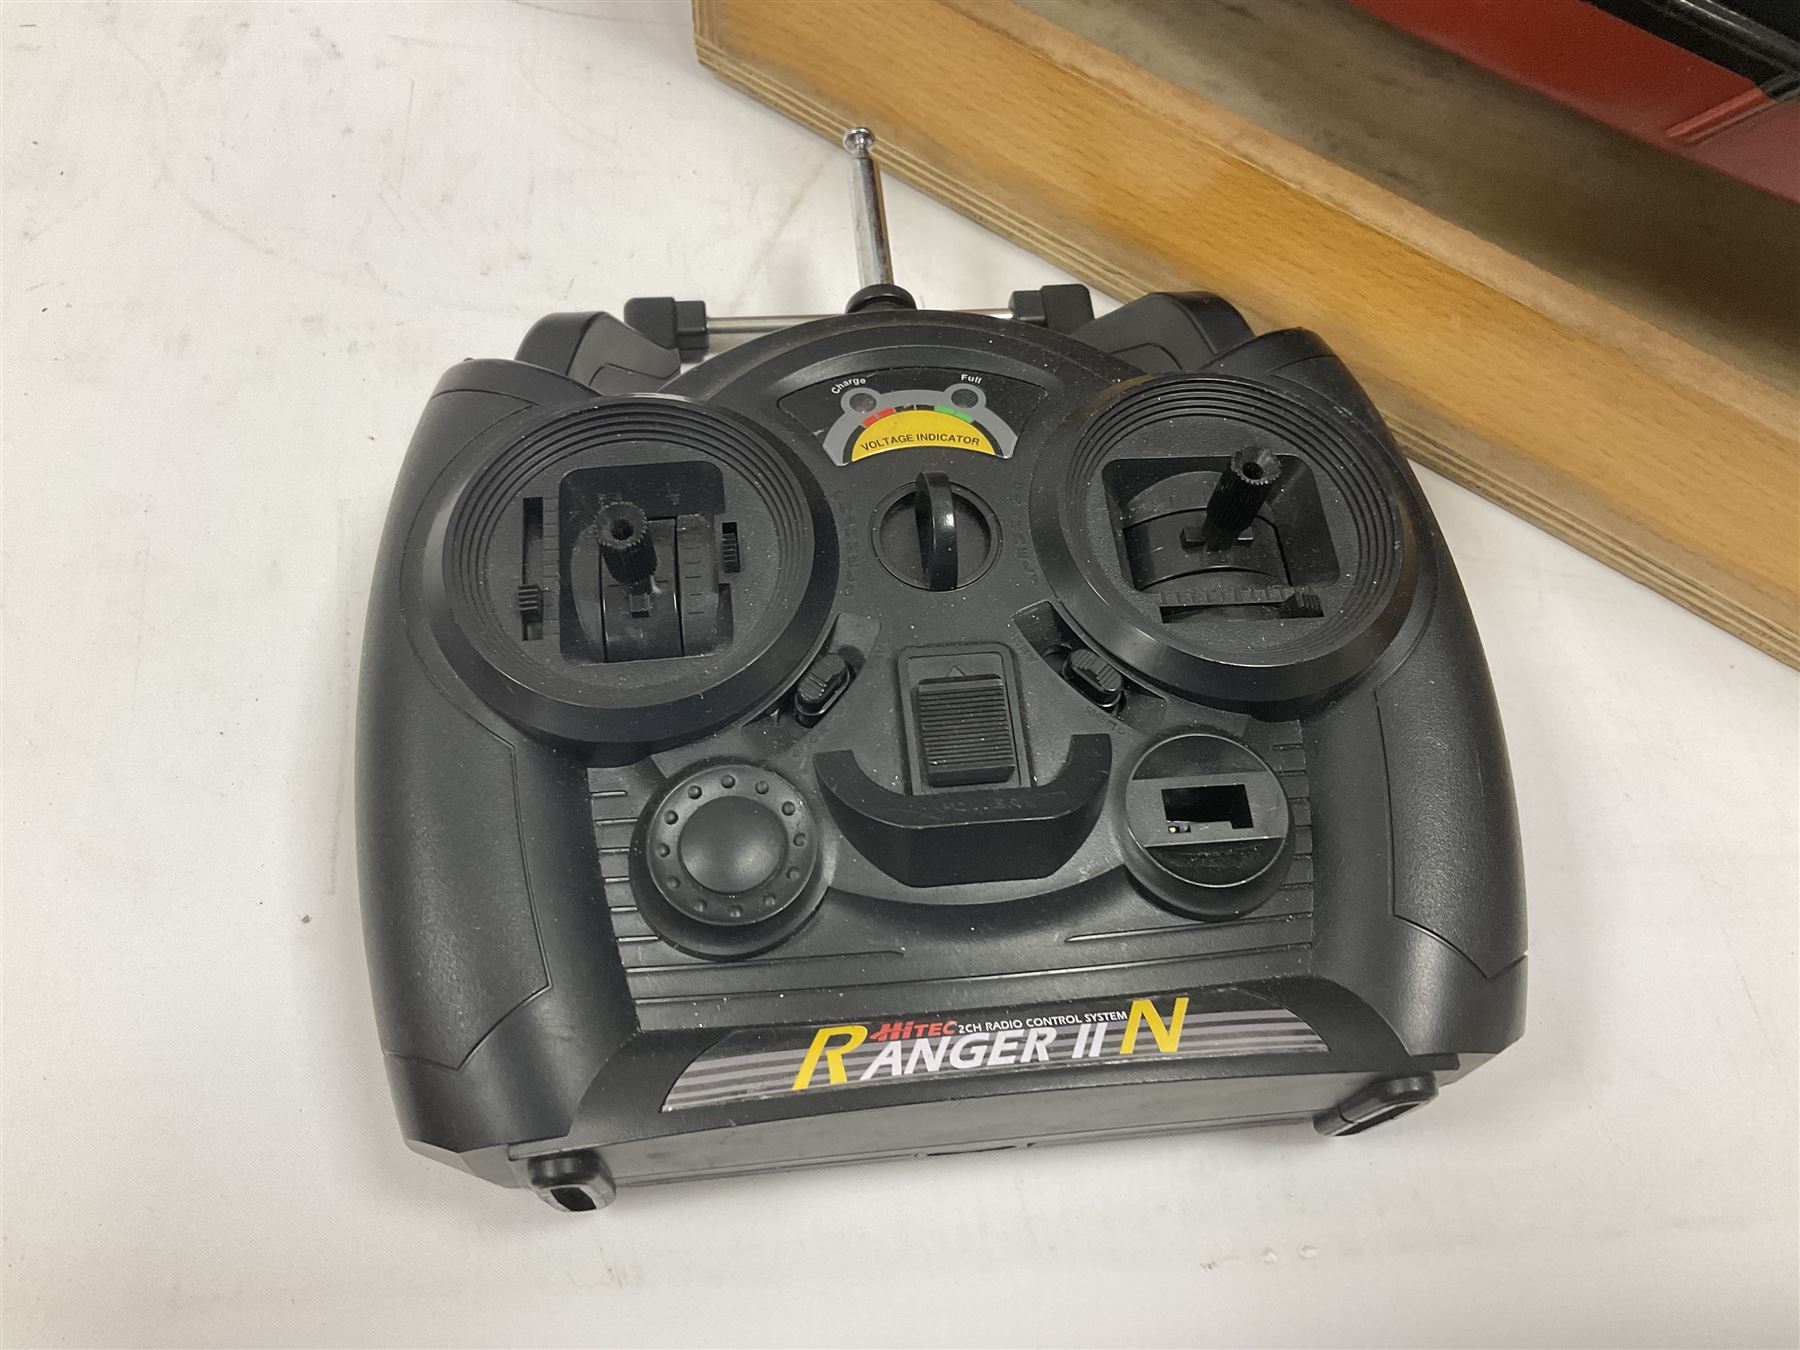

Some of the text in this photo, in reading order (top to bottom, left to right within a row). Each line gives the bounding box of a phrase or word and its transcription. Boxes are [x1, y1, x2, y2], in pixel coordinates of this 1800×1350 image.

[831, 376, 866, 395] Charge
[960, 373, 982, 385] Full
[860, 433, 980, 451] VOLTAGE INDICATOR
[958, 1021, 982, 1034] 2CH
[985, 1017, 1023, 1032] RADIO
[1026, 1013, 1082, 1029] CONTROL
[1084, 1010, 1128, 1024] SYSTEM
[1119, 997, 1188, 1055] N
